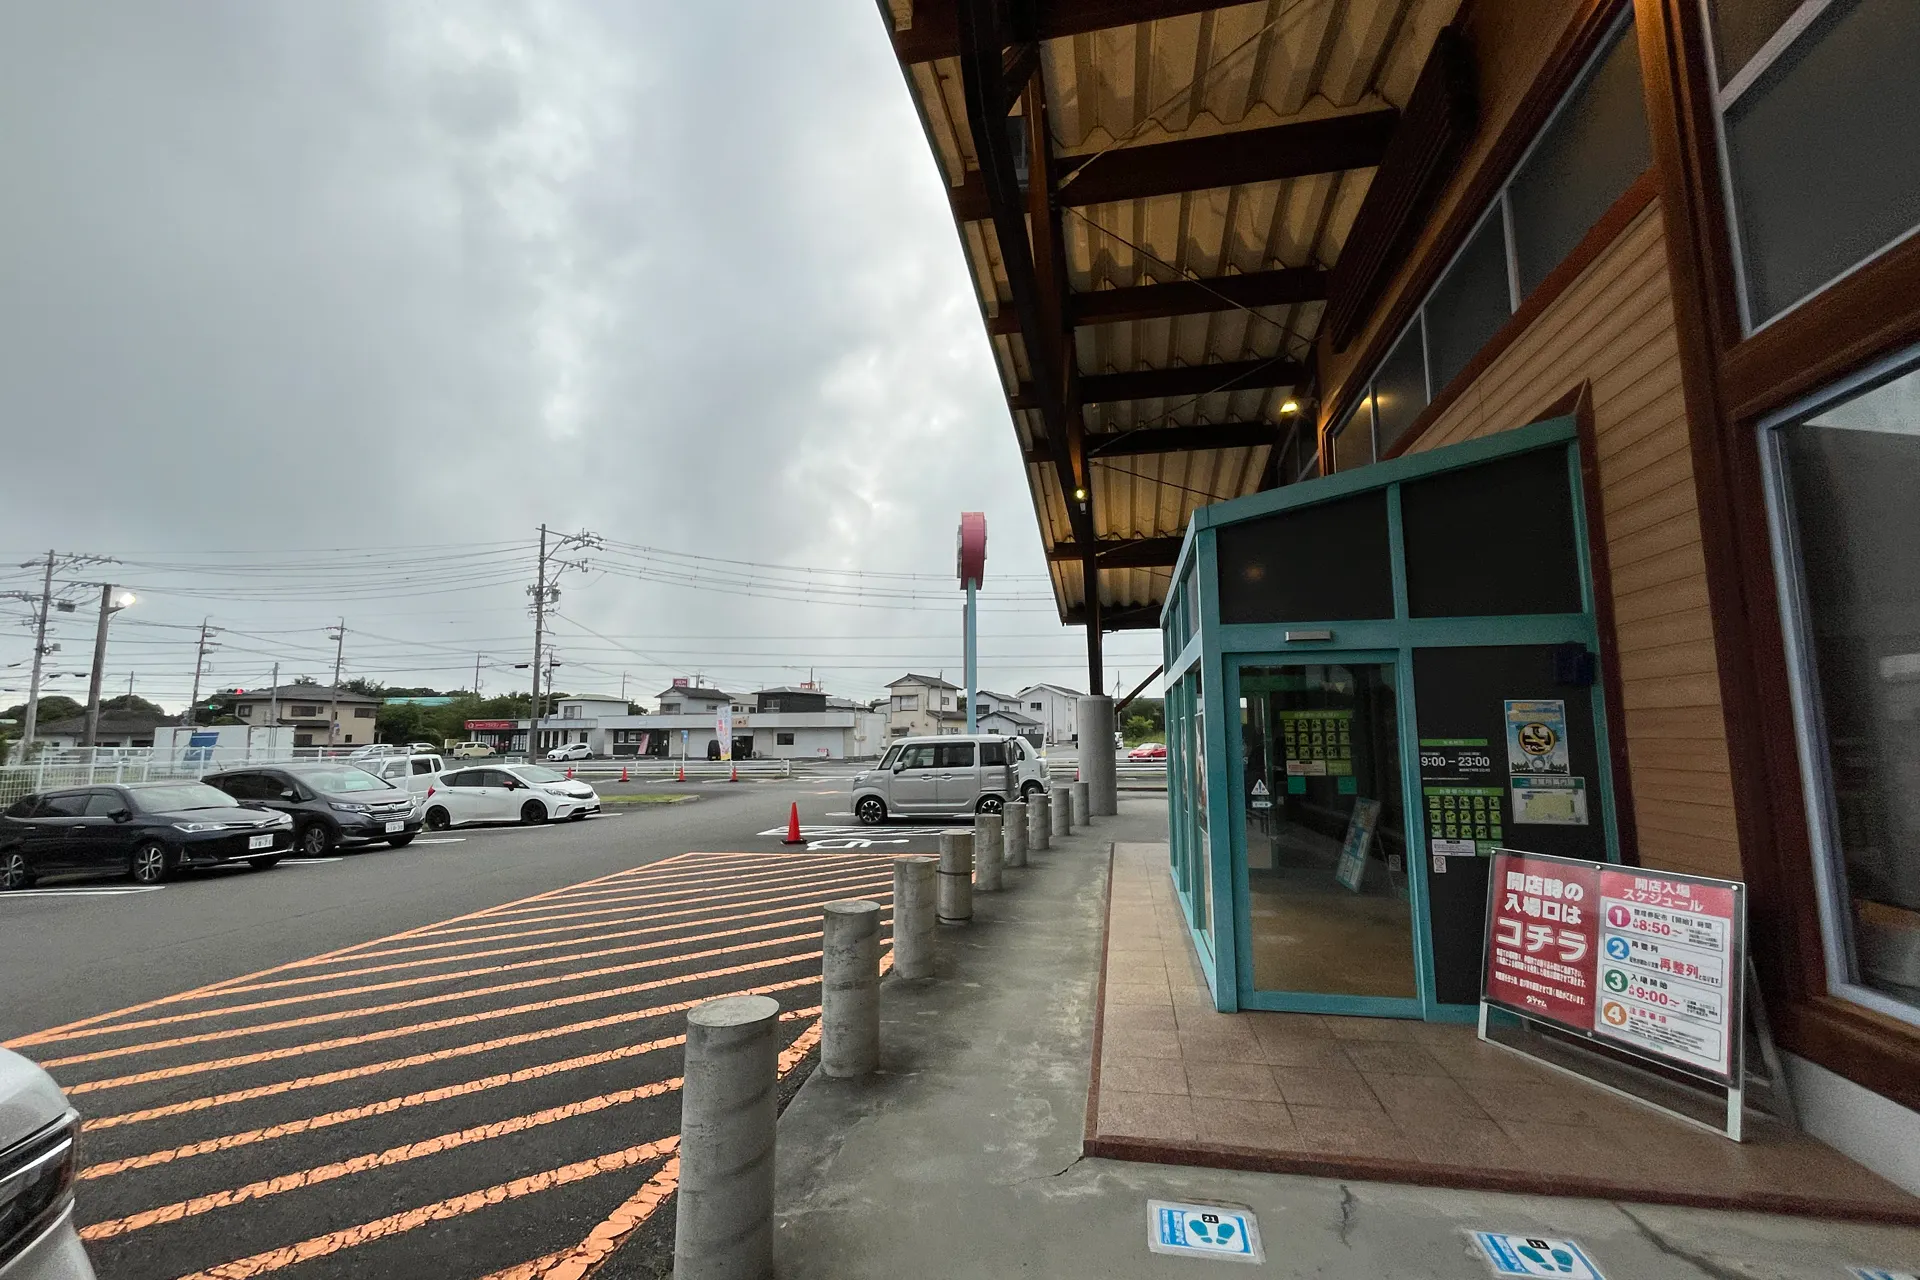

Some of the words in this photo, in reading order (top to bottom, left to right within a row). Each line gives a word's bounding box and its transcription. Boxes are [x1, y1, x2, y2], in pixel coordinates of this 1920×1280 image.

[1421, 757, 1446, 767] 9:00
[1458, 757, 1490, 767] 23:00
[1506, 871, 1584, 902] 開店時の
[1634, 877, 1691, 898] 開店入場
[1504, 892, 1582, 925] 入場口は
[1623, 888, 1704, 912] スケジュール
[1614, 909, 1622, 925] 1
[1496, 917, 1588, 962] コチラ
[1611, 940, 1625, 957] 2
[1631, 940, 1659, 953] 再整列
[1609, 972, 1622, 990] 3
[1631, 973, 1668, 989] 入場開始
[1608, 1006, 1622, 1022] 4
[1629, 1006, 1667, 1024] 注意事項
